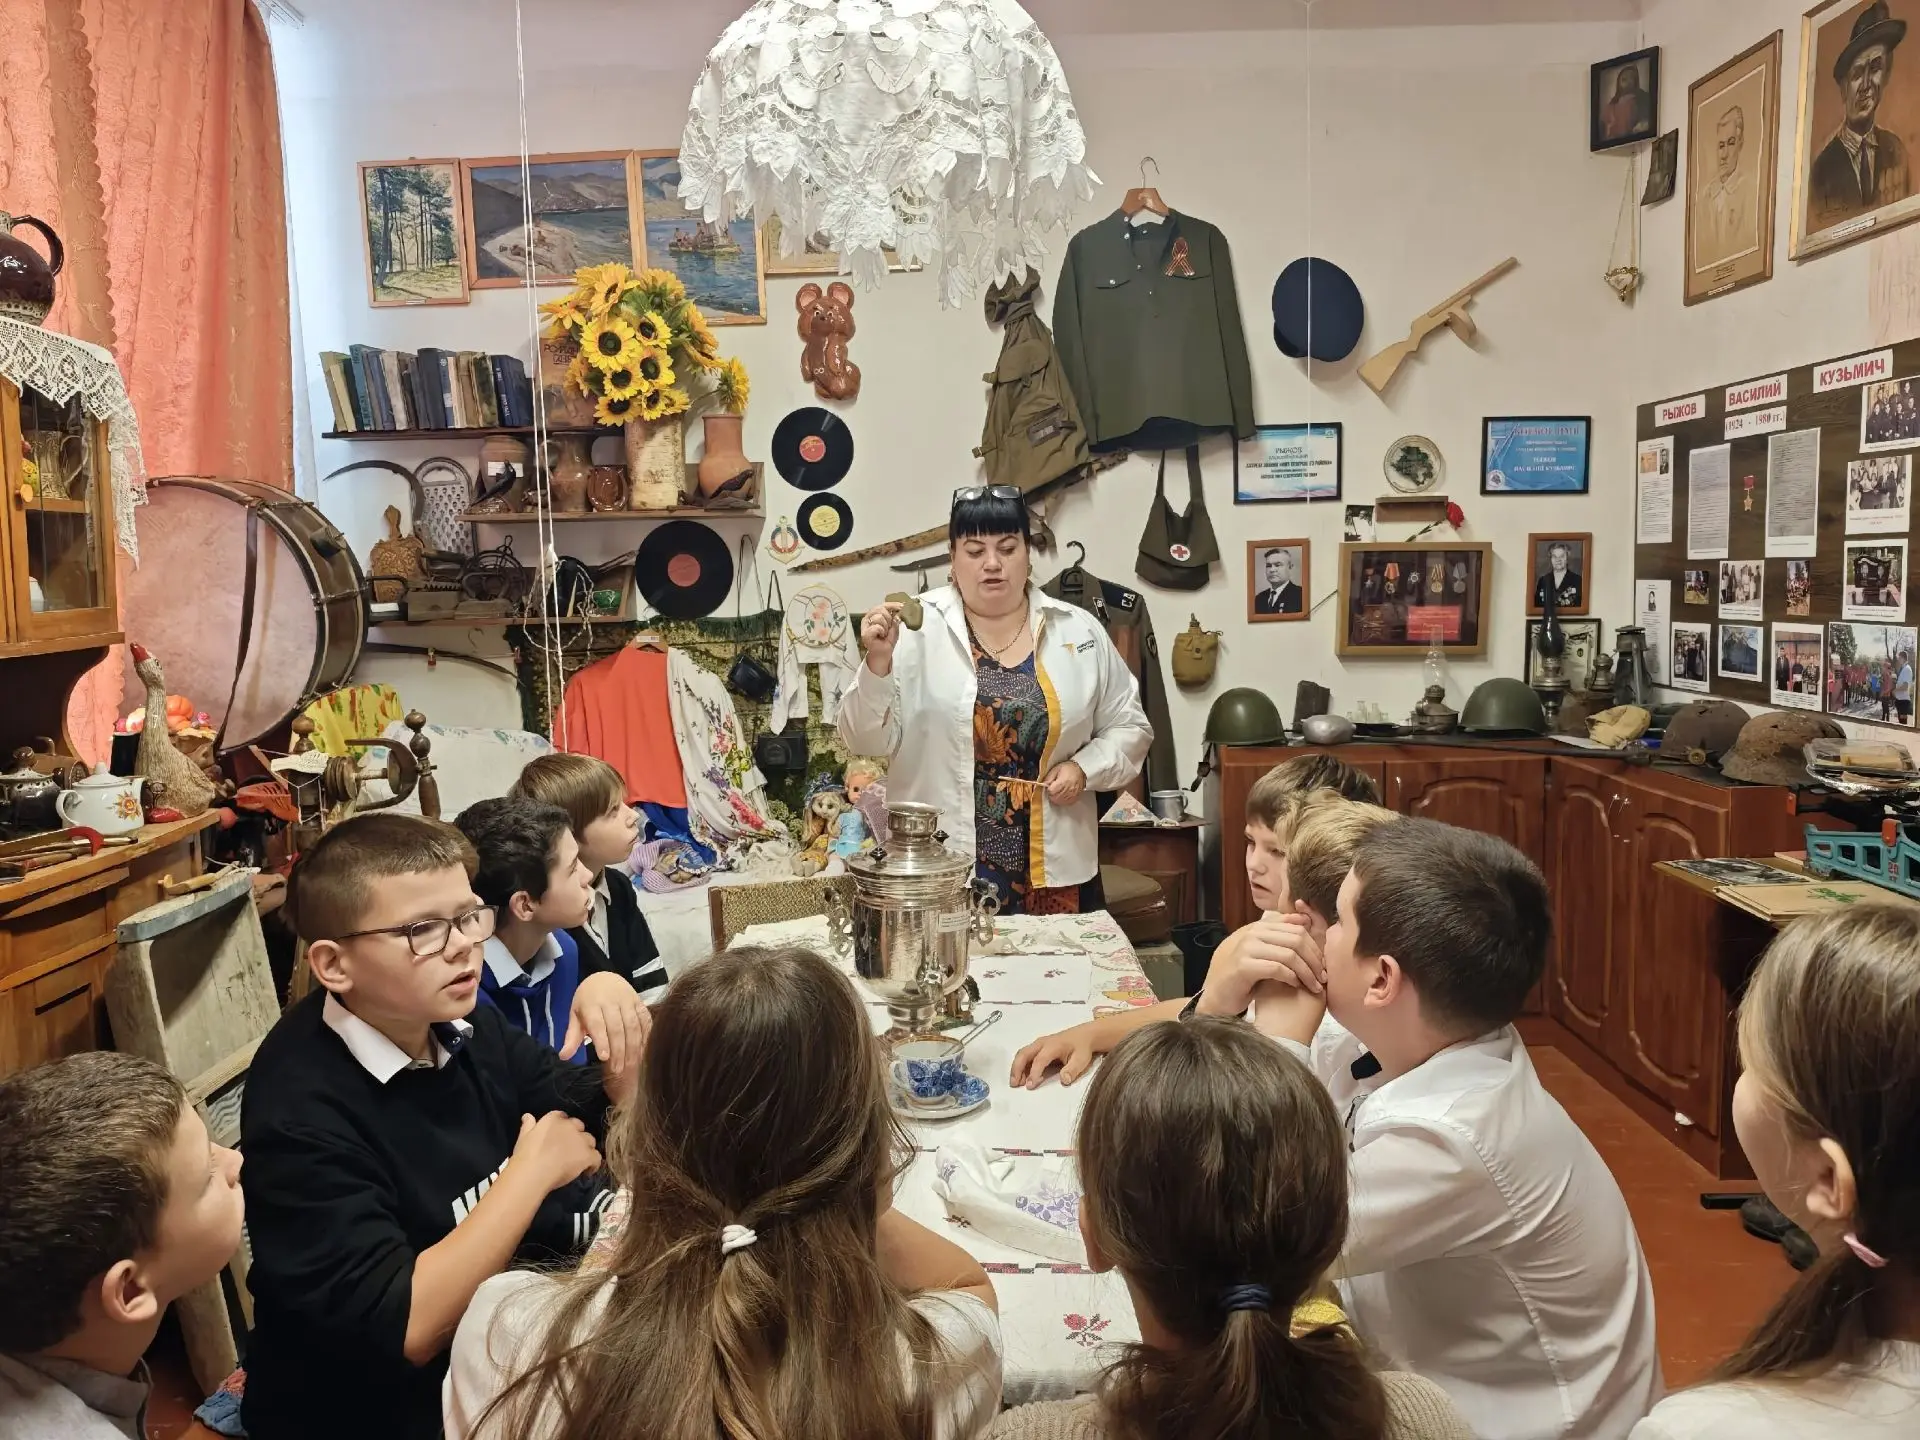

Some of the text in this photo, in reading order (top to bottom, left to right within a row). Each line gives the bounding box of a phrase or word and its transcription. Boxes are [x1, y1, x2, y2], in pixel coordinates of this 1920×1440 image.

[1819, 358, 1885, 386] КУЗЬМИЧ
[1728, 379, 1782, 406] ВАСИЛИЙ
[1662, 402, 1697, 420] РЫЖОВ
[1121, 592, 1136, 608] СА
